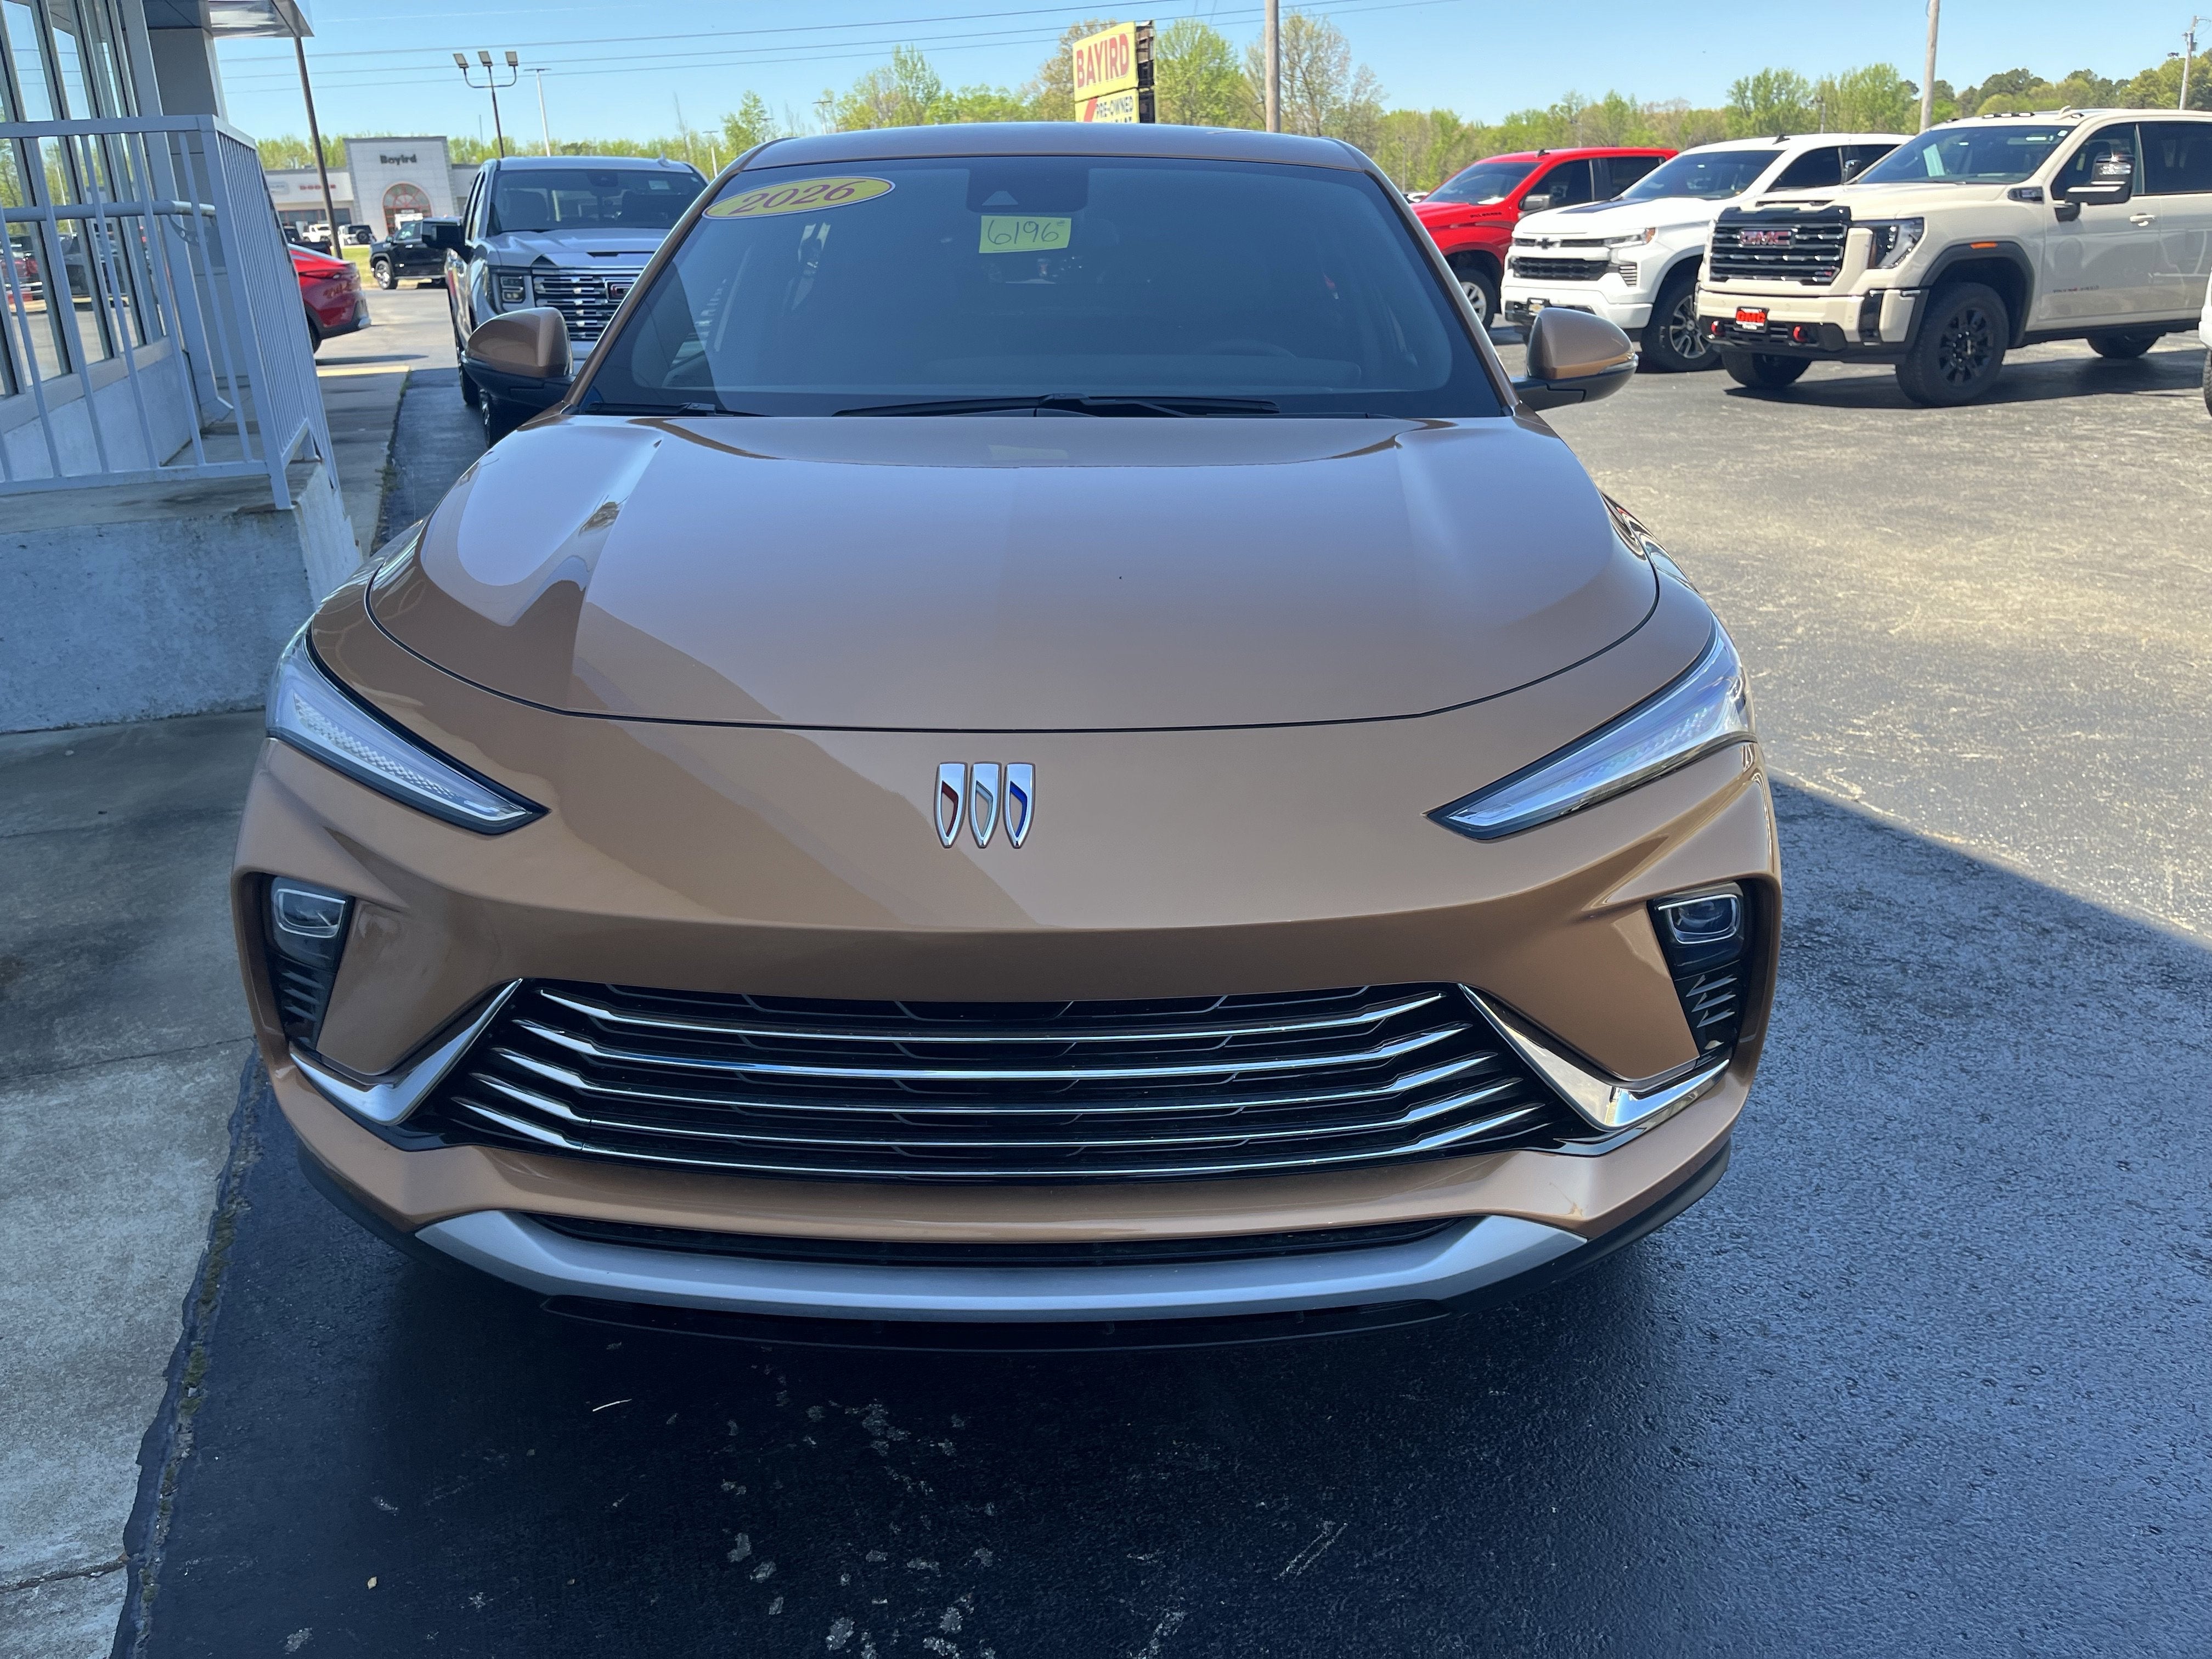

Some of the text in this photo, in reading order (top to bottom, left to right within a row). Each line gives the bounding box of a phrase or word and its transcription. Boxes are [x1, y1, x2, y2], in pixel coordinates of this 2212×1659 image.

[1076, 33, 1130, 88] BAYIRD
[1096, 95, 1134, 119] PRE-OWNED
[380, 154, 417, 166] Bayird
[727, 180, 867, 215] 2026
[988, 219, 1059, 245] 6196
[1741, 231, 1791, 246] GMC
[1736, 311, 1766, 323] GMC
